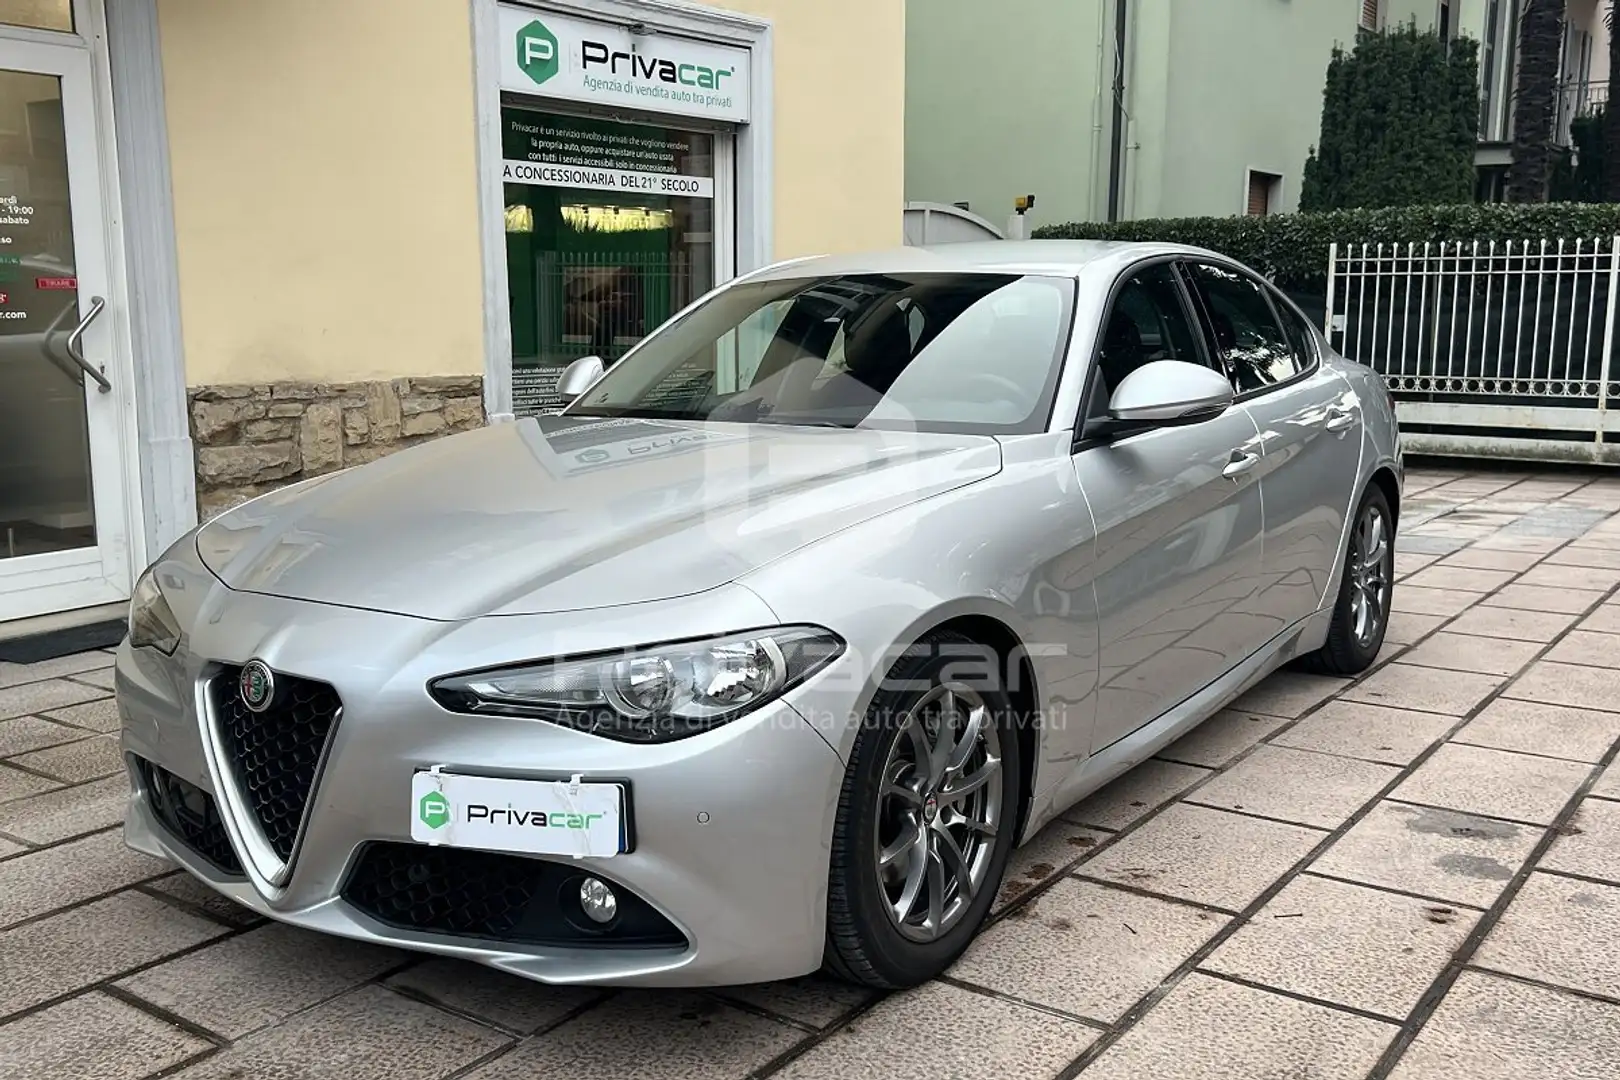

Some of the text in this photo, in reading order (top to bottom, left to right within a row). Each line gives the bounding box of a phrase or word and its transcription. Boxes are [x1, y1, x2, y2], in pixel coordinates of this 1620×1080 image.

[582, 40, 732, 90] Privacar
[583, 75, 732, 108] Agenzia di vendita auto tra privati
[512, 121, 539, 133] Privacar
[555, 128, 580, 138] servizio
[581, 131, 601, 141] rivolto
[602, 133, 608, 141] ai
[609, 134, 628, 144] privati
[629, 136, 639, 145] che
[641, 138, 666, 148] vogliono
[667, 141, 689, 151] vendere
[531, 136, 538, 147] la
[539, 140, 562, 150] propria
[581, 144, 604, 154] oppure
[605, 147, 635, 157] acquistare
[659, 153, 674, 162] usata
[528, 152, 541, 160] con
[542, 153, 557, 162] tutti
[563, 155, 583, 164] servizi
[584, 157, 614, 168] accessibili
[616, 159, 628, 169] solo
[636, 162, 677, 174] concessionaria
[515, 165, 616, 186] CONCESSIONARIA
[621, 175, 640, 188] DEL
[661, 178, 699, 192] SECOLO
[8, 205, 34, 215] 19:00
[467, 802, 602, 830] Privacar
